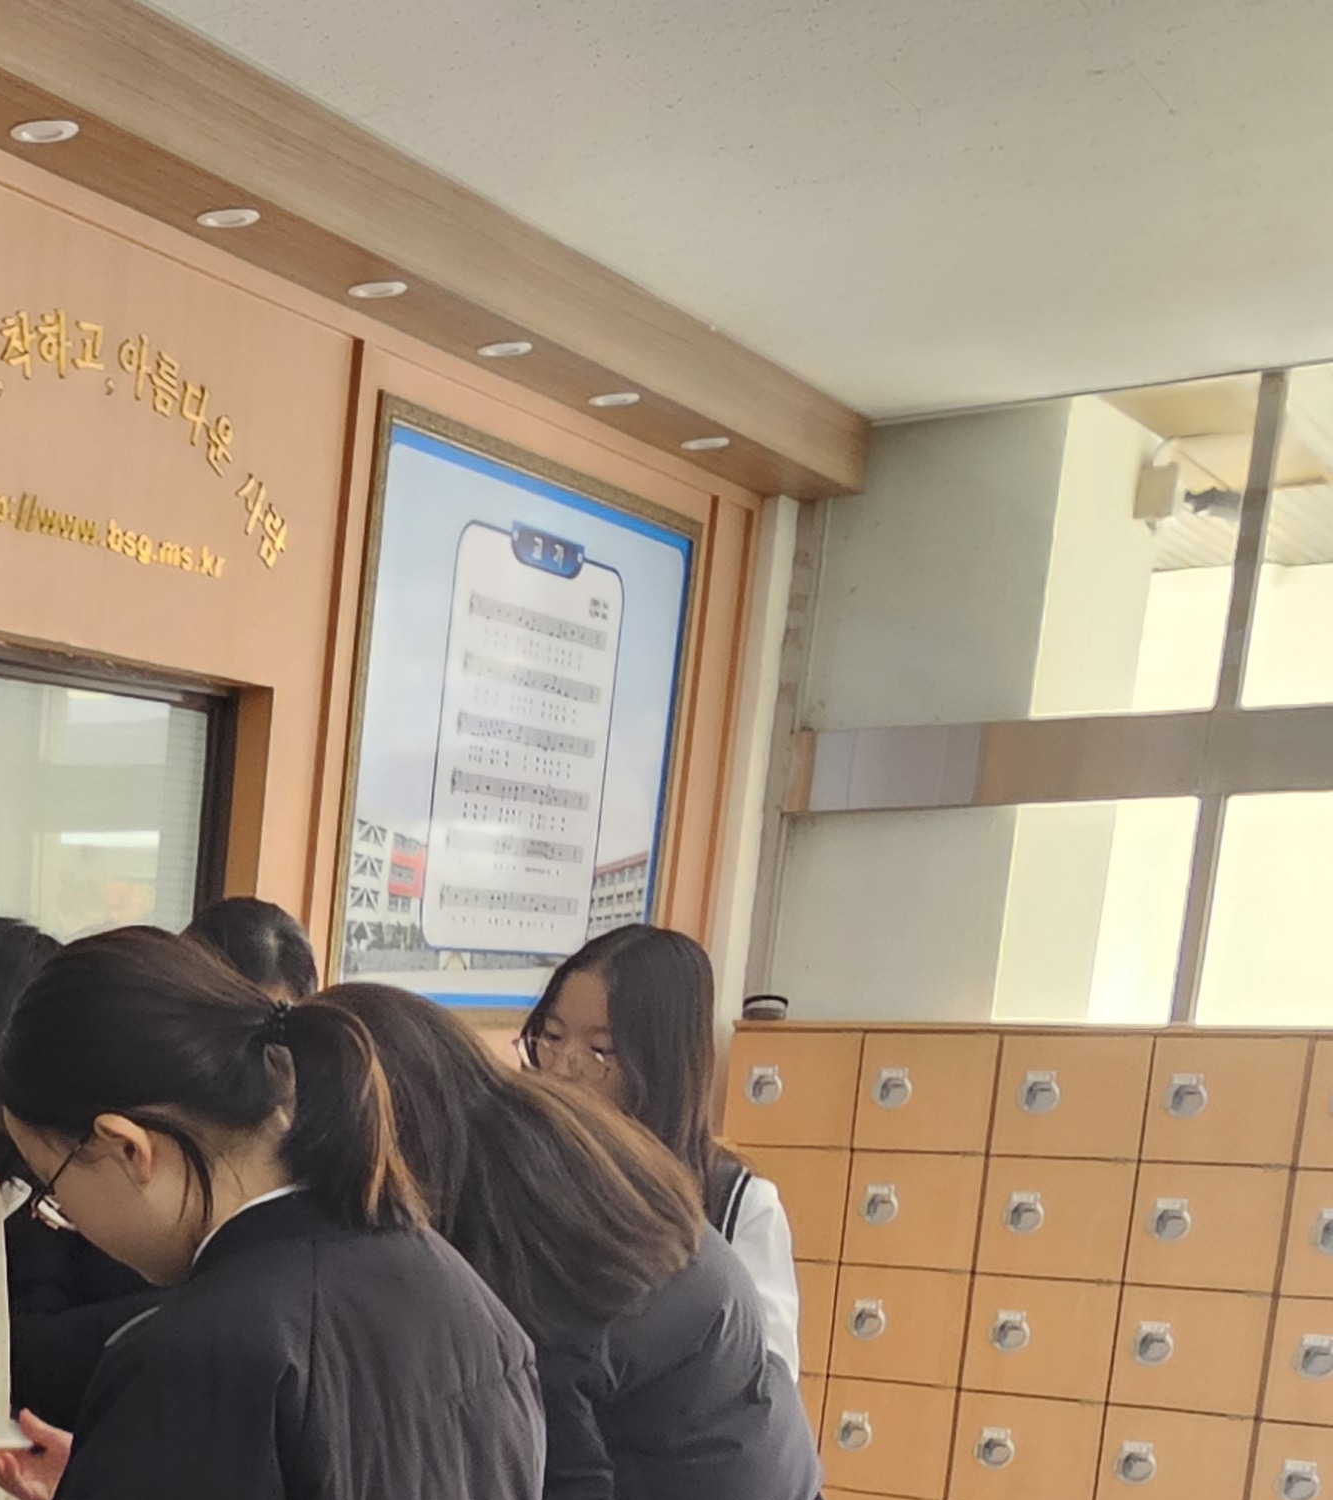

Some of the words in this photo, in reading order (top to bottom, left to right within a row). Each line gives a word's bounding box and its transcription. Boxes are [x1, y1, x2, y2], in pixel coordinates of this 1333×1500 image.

[0, 308, 116, 397] 착하고,
[118, 334, 235, 477] 아름다운
[235, 473, 289, 569] 사람
